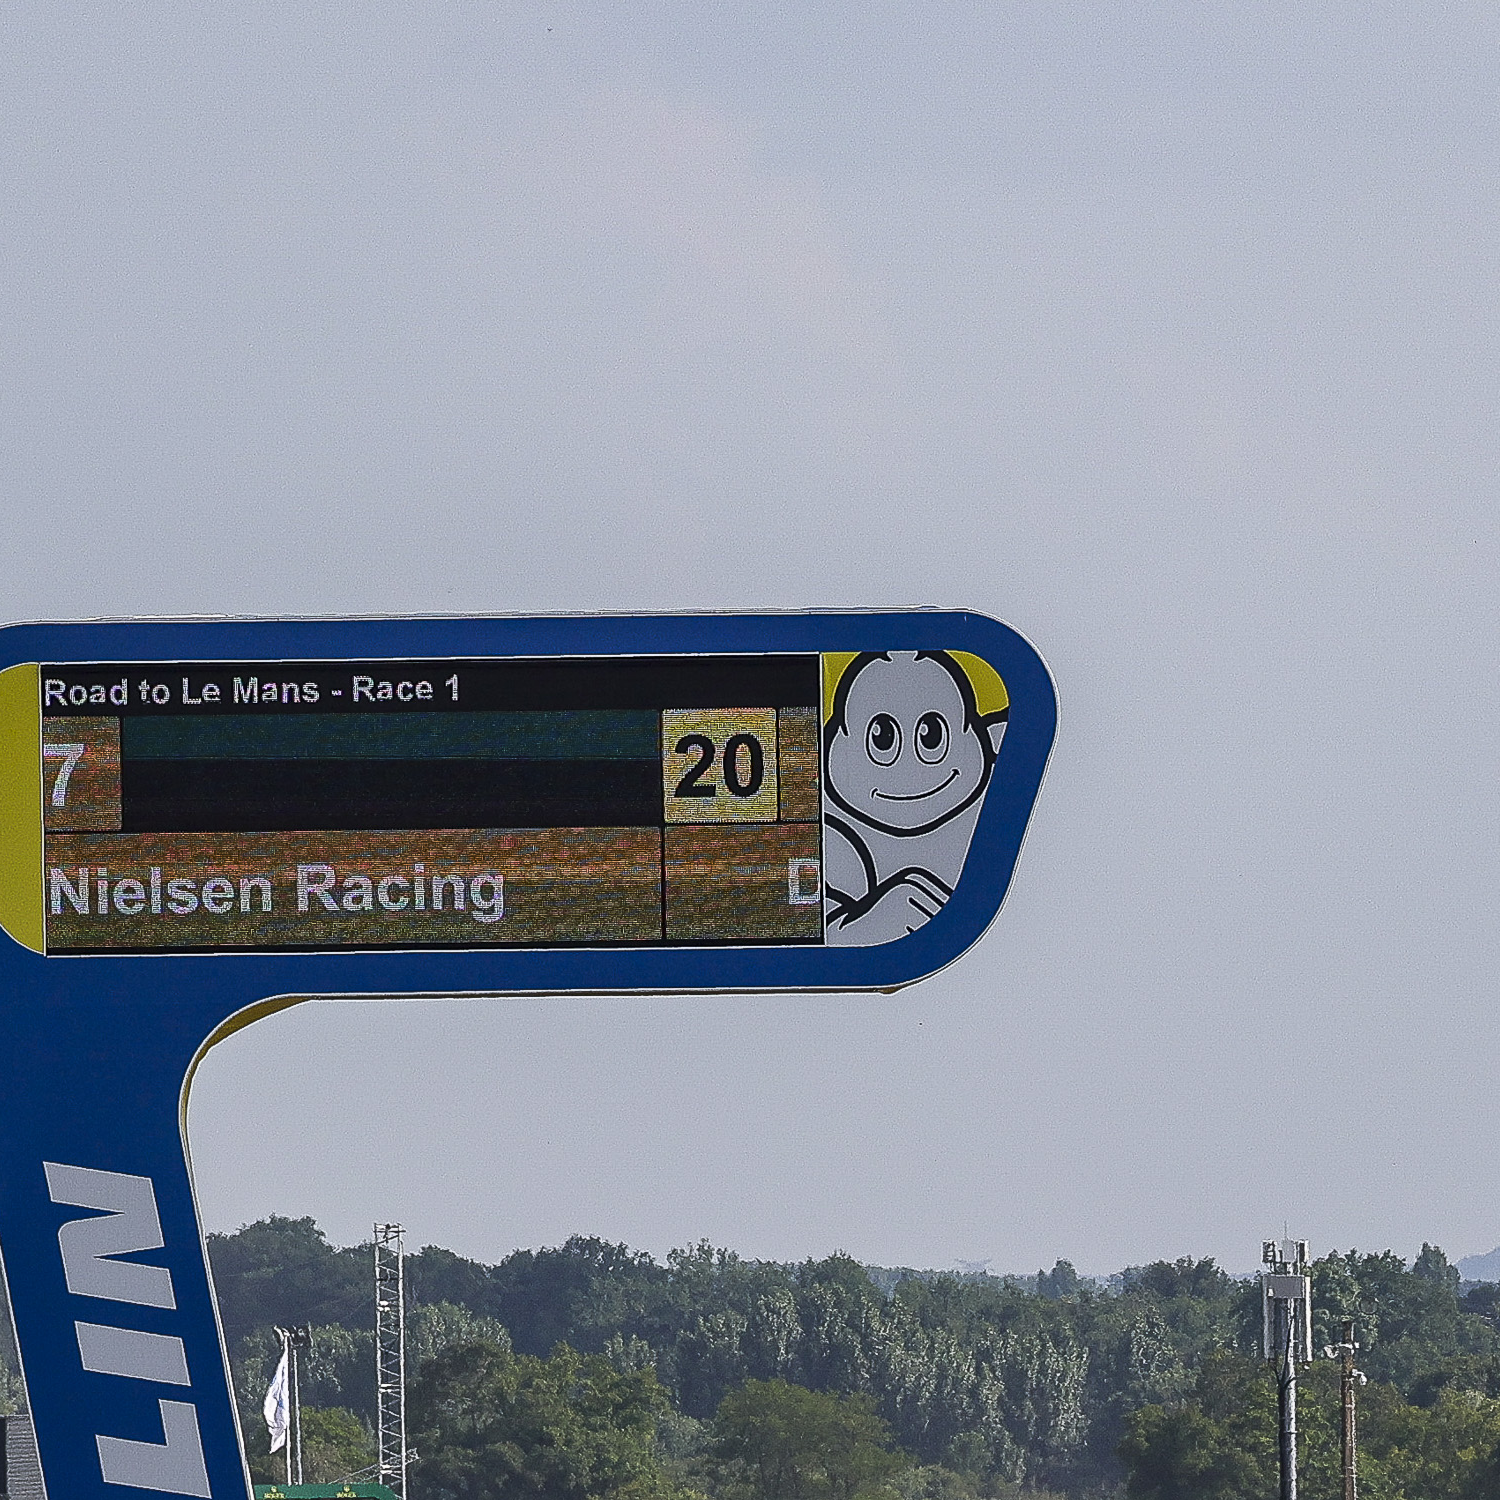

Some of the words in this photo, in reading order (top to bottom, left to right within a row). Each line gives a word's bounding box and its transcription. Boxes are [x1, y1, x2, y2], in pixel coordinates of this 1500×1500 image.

[43, 676, 128, 708] Road
[139, 679, 170, 707] to
[183, 677, 221, 706] Le
[234, 676, 318, 706] Mans
[352, 675, 434, 705] Race
[445, 675, 460, 702] 1
[42, 743, 85, 807] 7
[672, 733, 764, 798] 20
[49, 864, 274, 917] Nielsen
[298, 862, 505, 924] Racing
